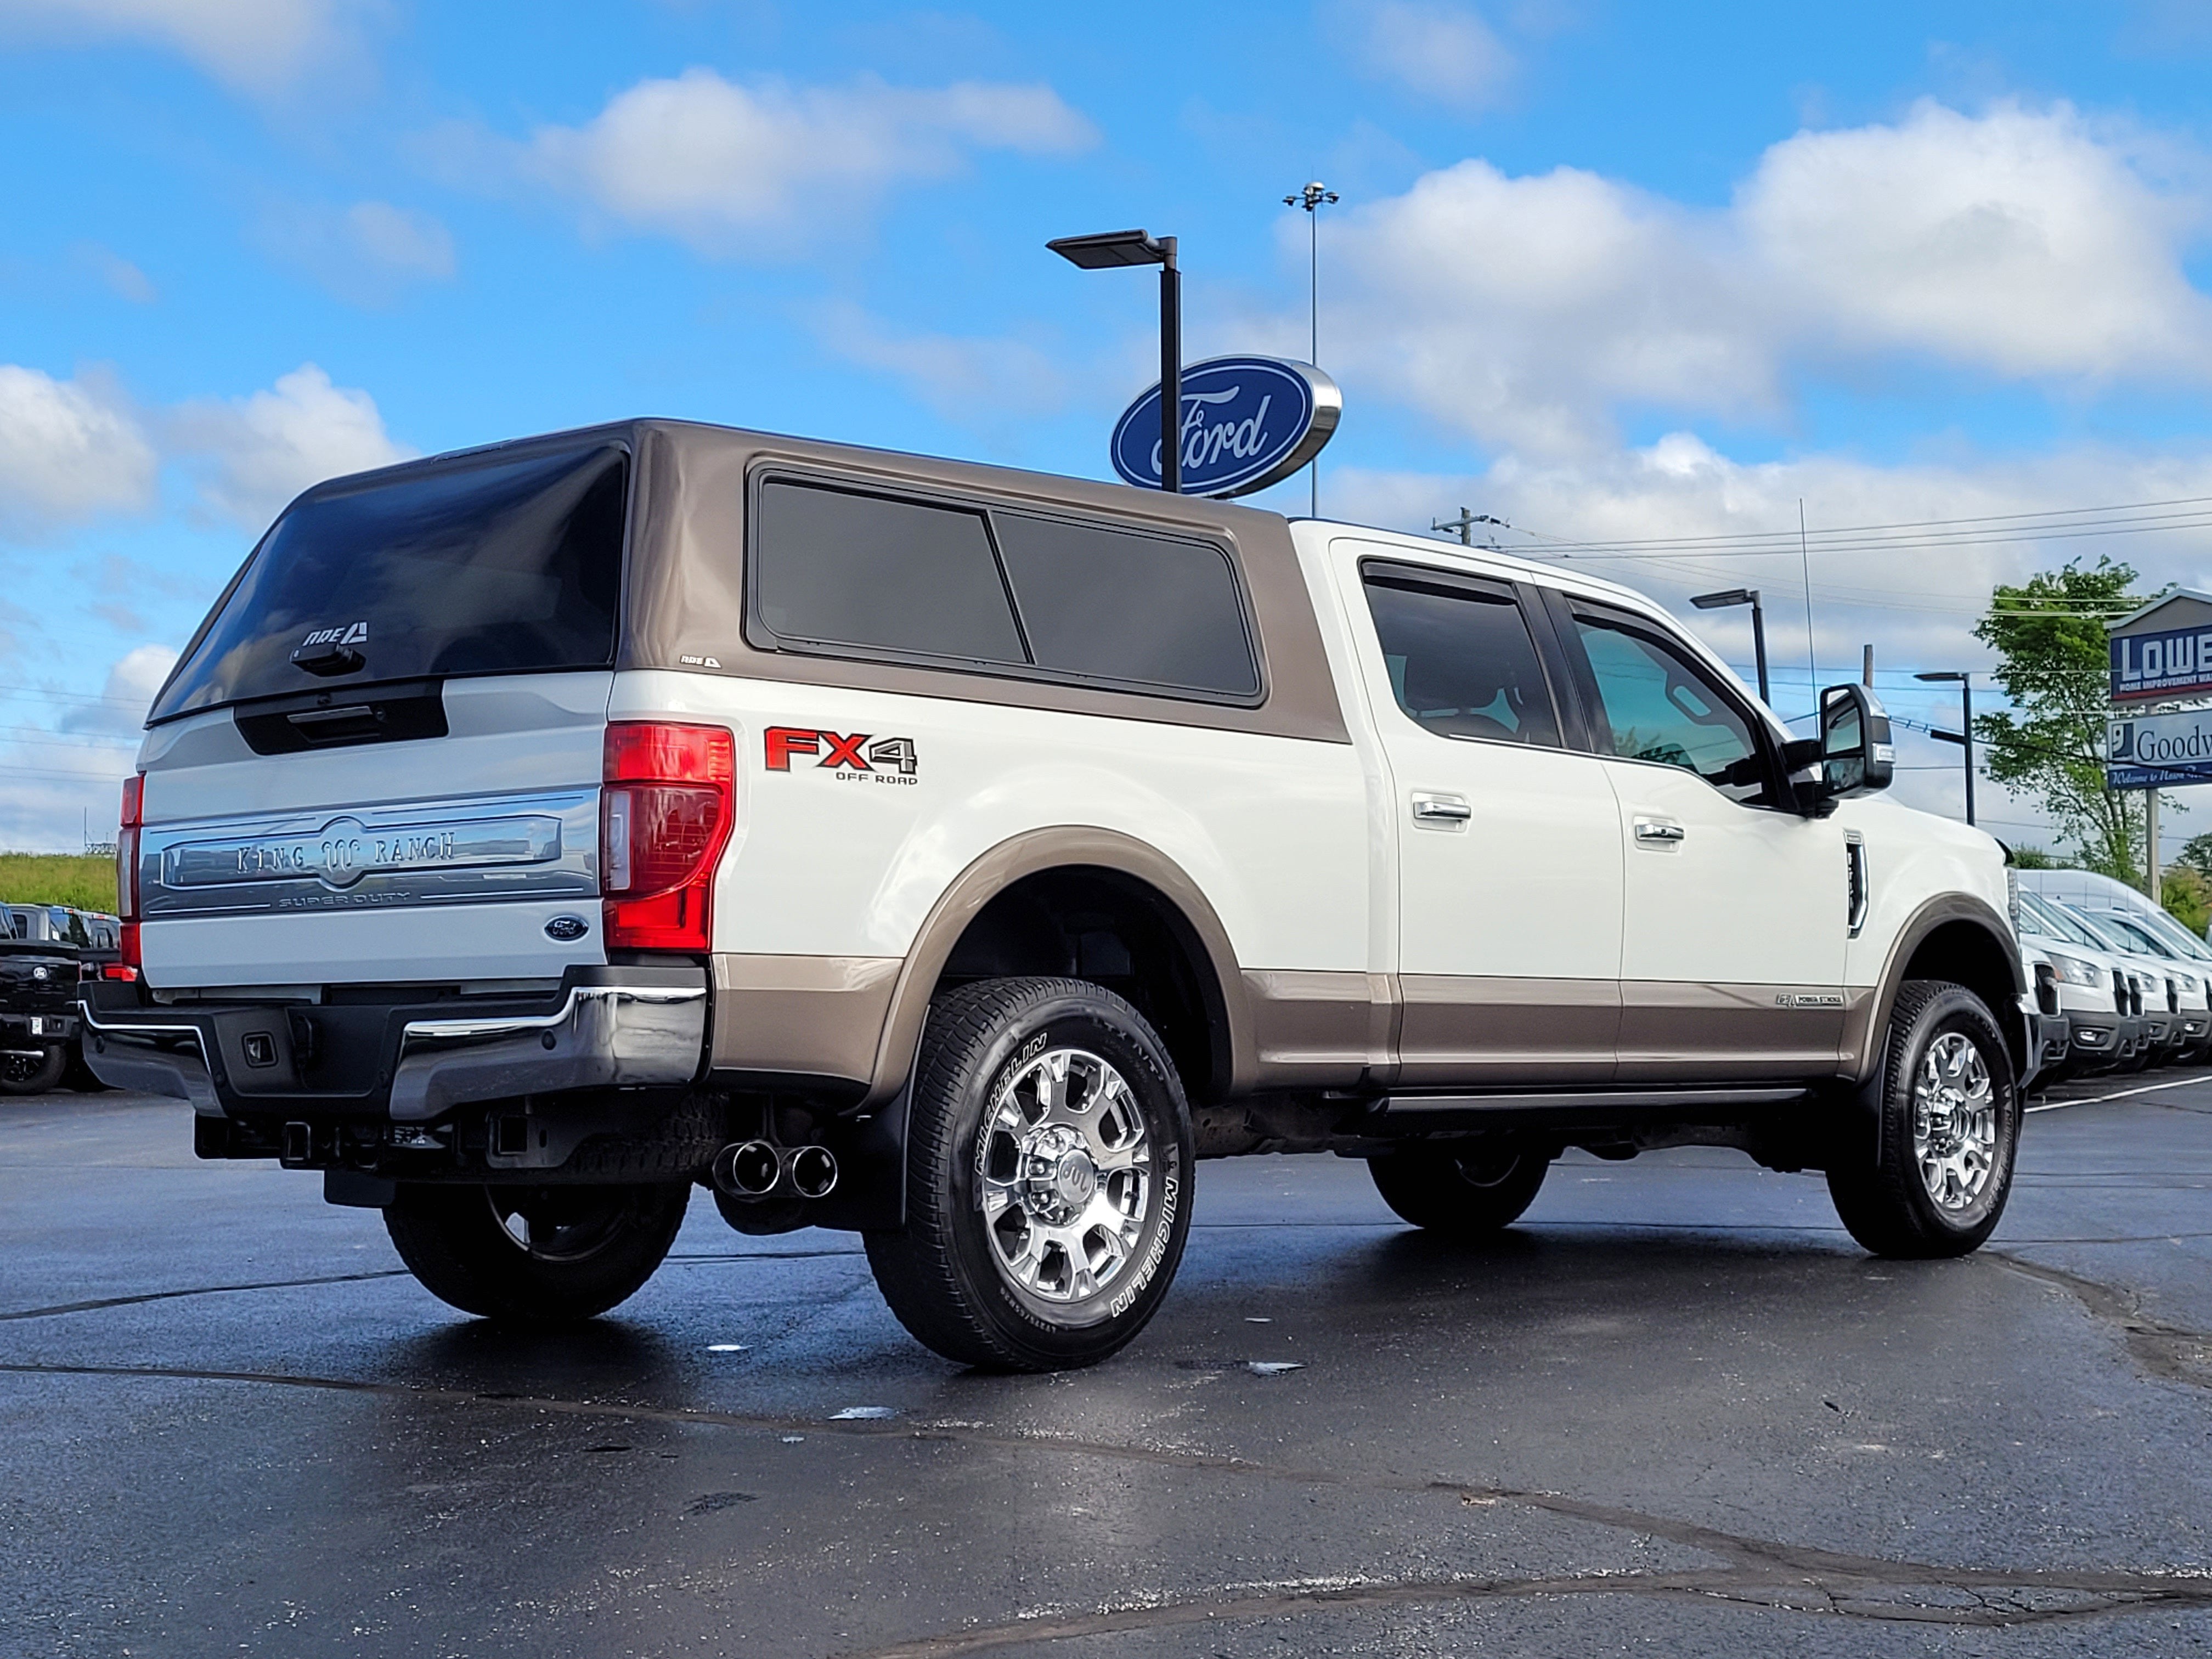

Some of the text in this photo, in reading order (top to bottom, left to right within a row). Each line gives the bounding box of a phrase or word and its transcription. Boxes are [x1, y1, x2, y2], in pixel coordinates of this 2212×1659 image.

[1152, 385, 1271, 476] Ford
[2122, 633, 2212, 682] LOWE
[2142, 675, 2197, 690] IMPROVEMENT
[764, 726, 917, 775] FX4
[836, 771, 918, 786] OFF ROAD
[238, 831, 455, 874] KING RANCH
[279, 891, 410, 908] SUPER DUTY
[552, 921, 577, 935] Ford
[974, 1032, 1047, 1176] MICHELIN
[1110, 1176, 1179, 1318] MICHELIN
